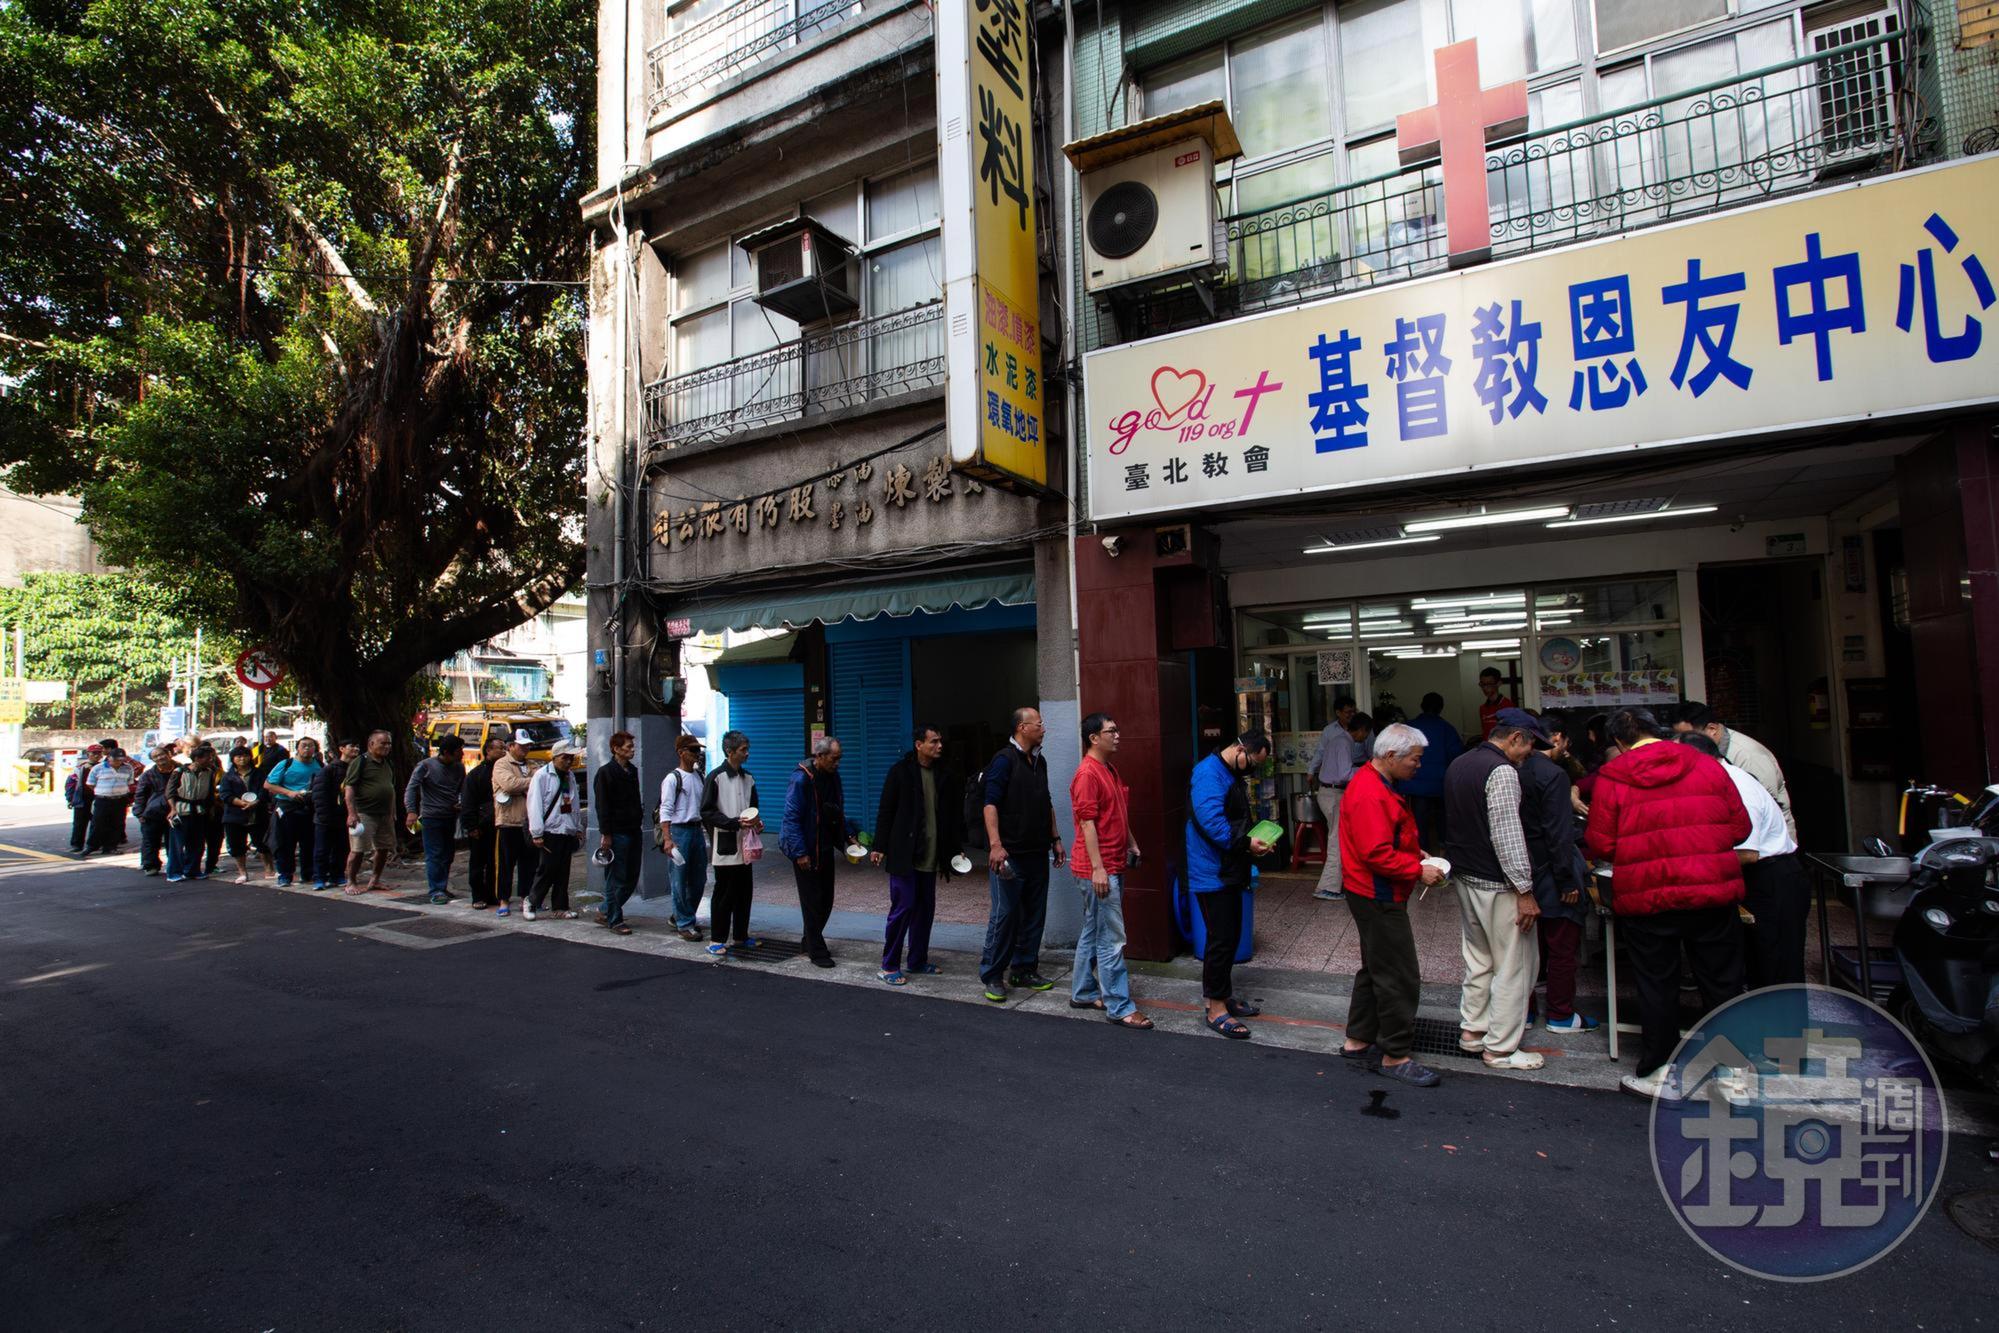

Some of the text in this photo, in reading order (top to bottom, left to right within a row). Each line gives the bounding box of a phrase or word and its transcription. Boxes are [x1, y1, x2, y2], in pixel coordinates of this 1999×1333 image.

[985, 341, 1038, 401] 水泥漆
[1178, 418, 1237, 444] 119 org
